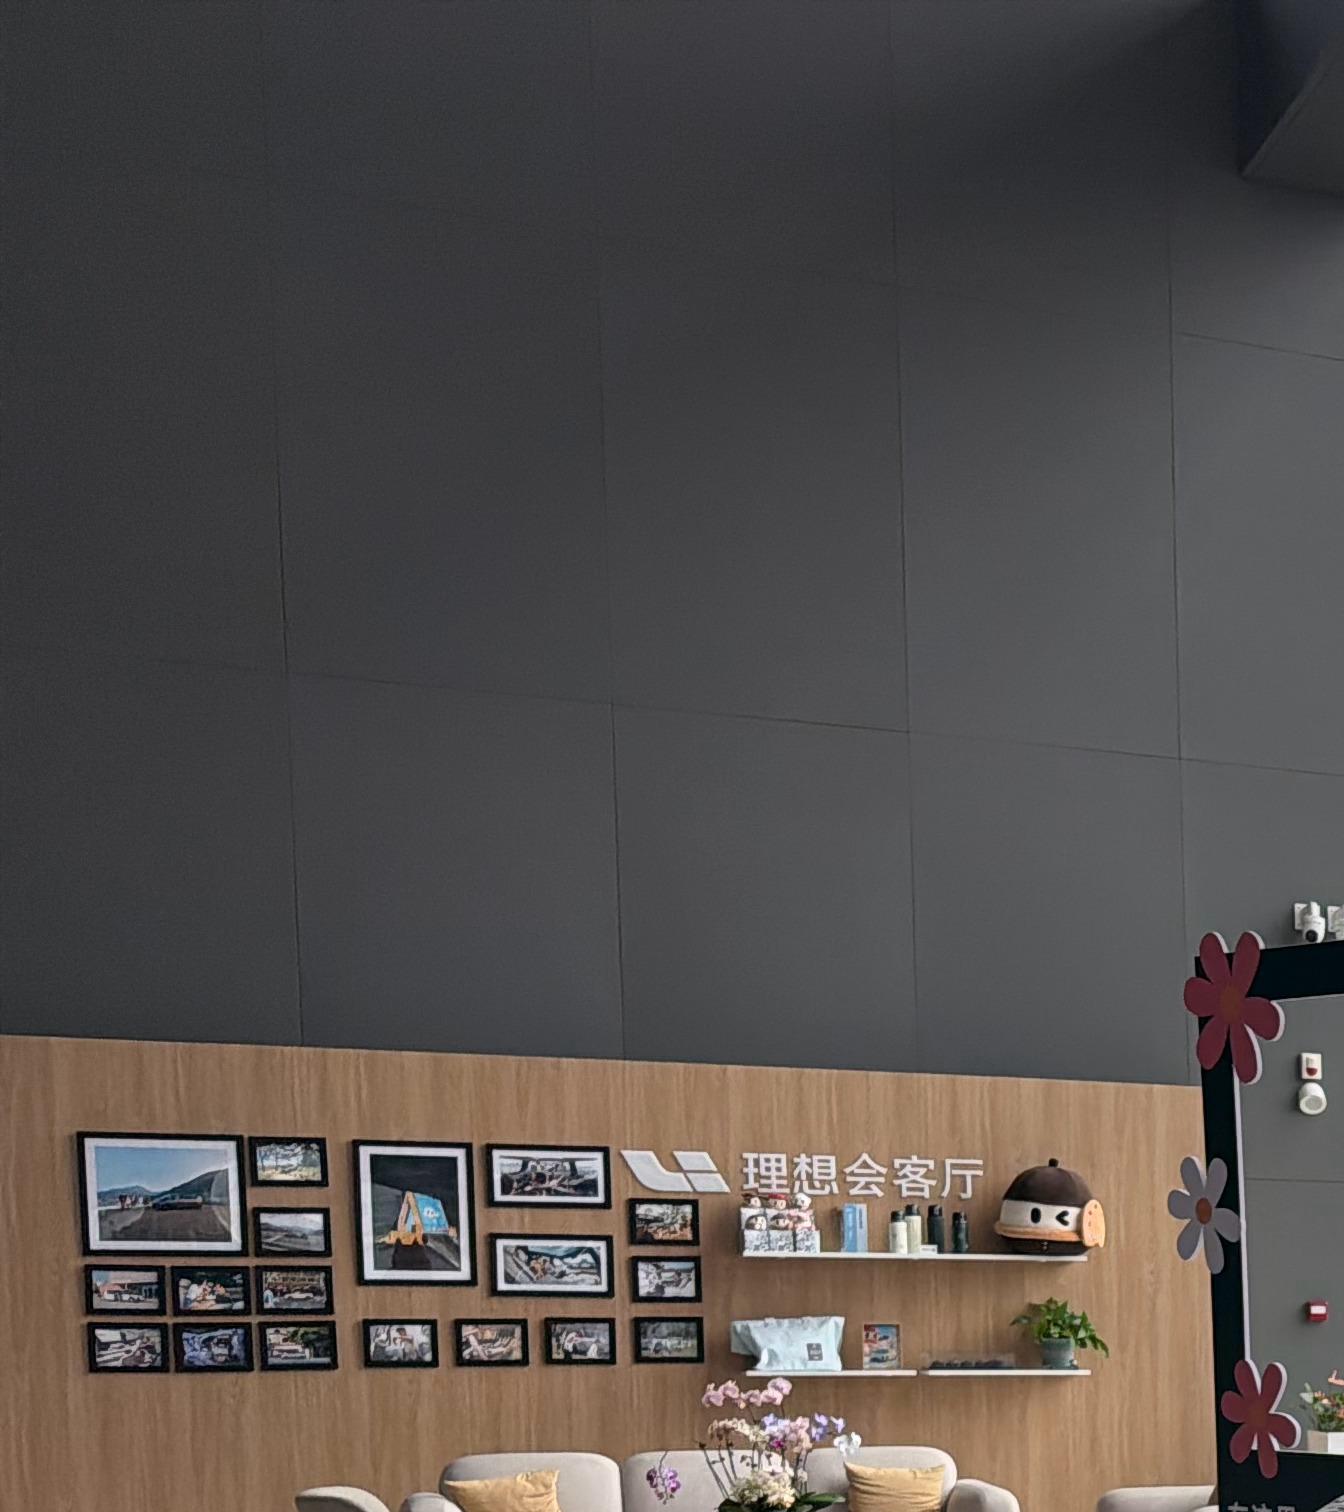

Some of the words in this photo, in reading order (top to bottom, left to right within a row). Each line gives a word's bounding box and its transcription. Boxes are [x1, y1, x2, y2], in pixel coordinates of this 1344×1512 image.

[741, 1151, 985, 1200] 理想会客厅
